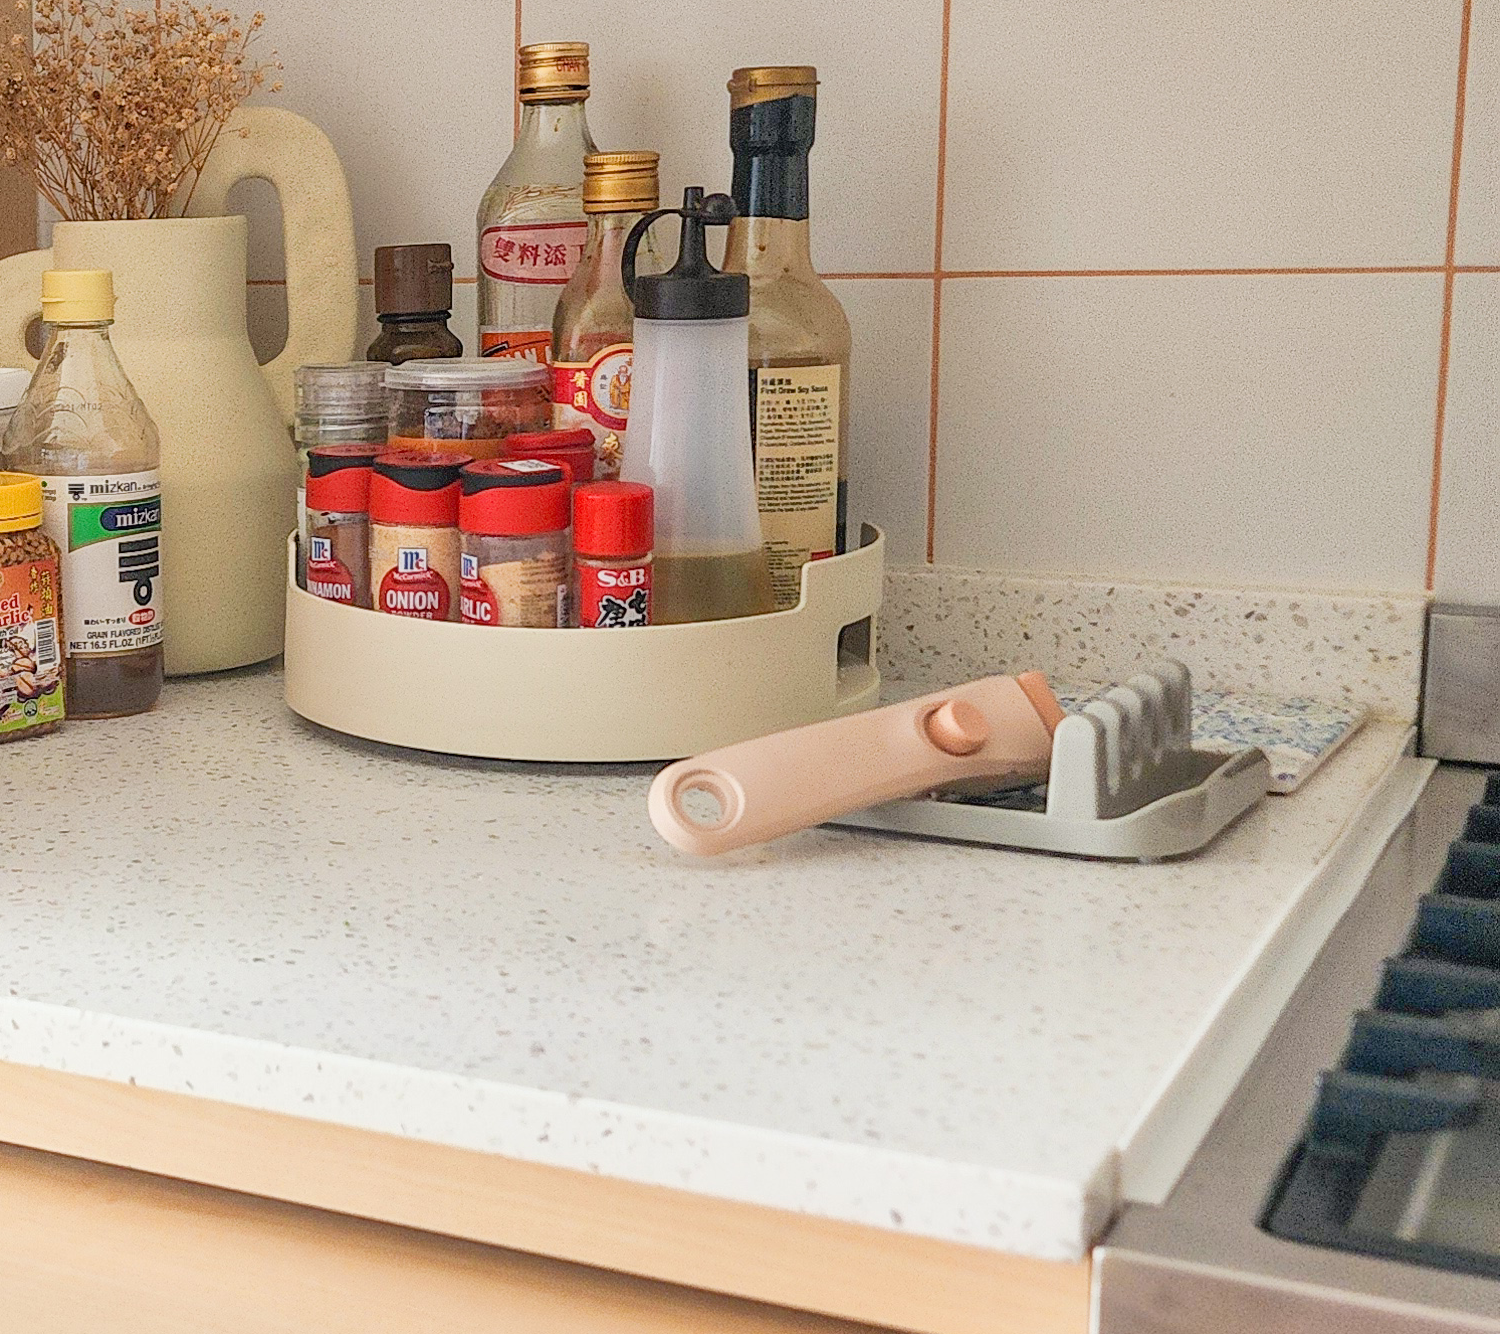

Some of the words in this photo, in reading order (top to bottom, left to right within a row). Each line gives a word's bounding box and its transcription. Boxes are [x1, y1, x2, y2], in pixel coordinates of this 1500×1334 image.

[597, 568, 645, 587] S&B
[386, 589, 439, 610] ONION
[87, 630, 108, 639] GRAIN
[70, 641, 88, 649] NET
